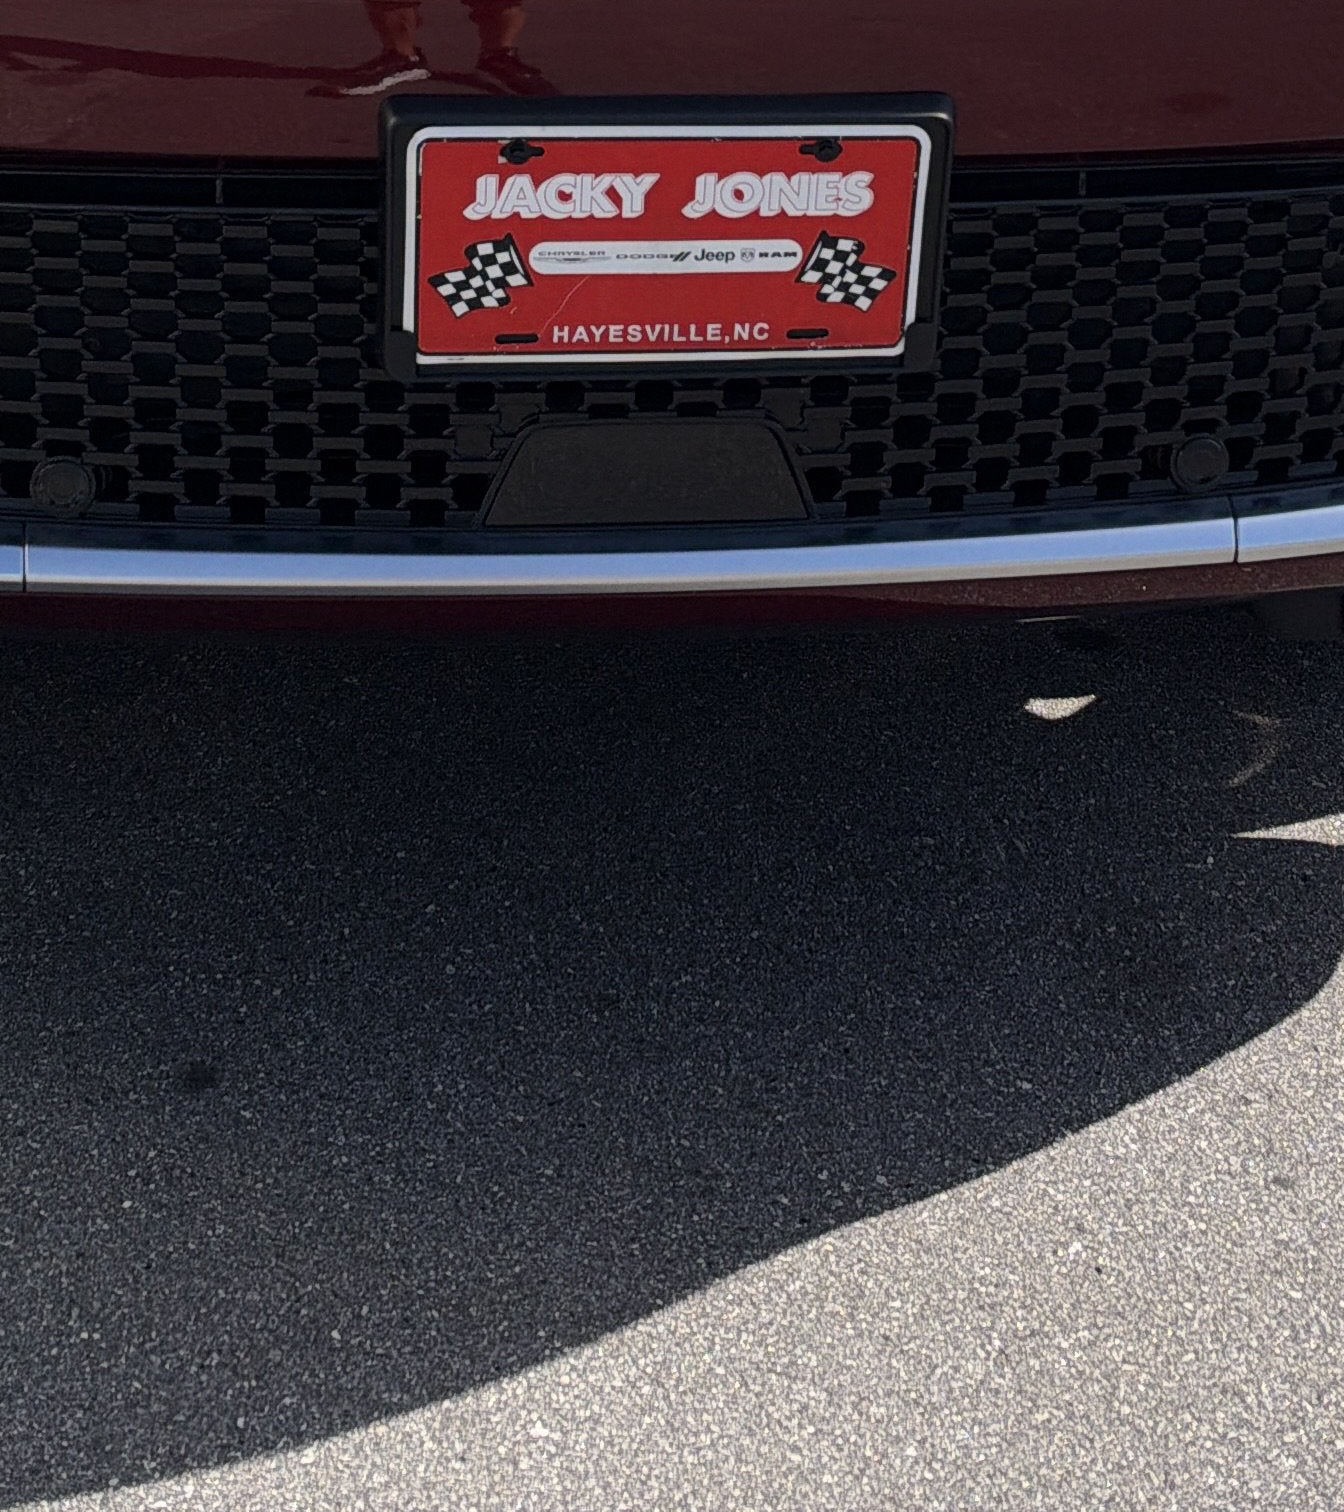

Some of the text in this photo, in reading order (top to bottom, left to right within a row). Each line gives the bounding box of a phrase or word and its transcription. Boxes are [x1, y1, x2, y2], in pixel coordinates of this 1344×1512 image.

[462, 170, 875, 221] JACKY JONES
[694, 247, 736, 264] Jeep
[552, 322, 771, 344] HAYESVILLE,NC
